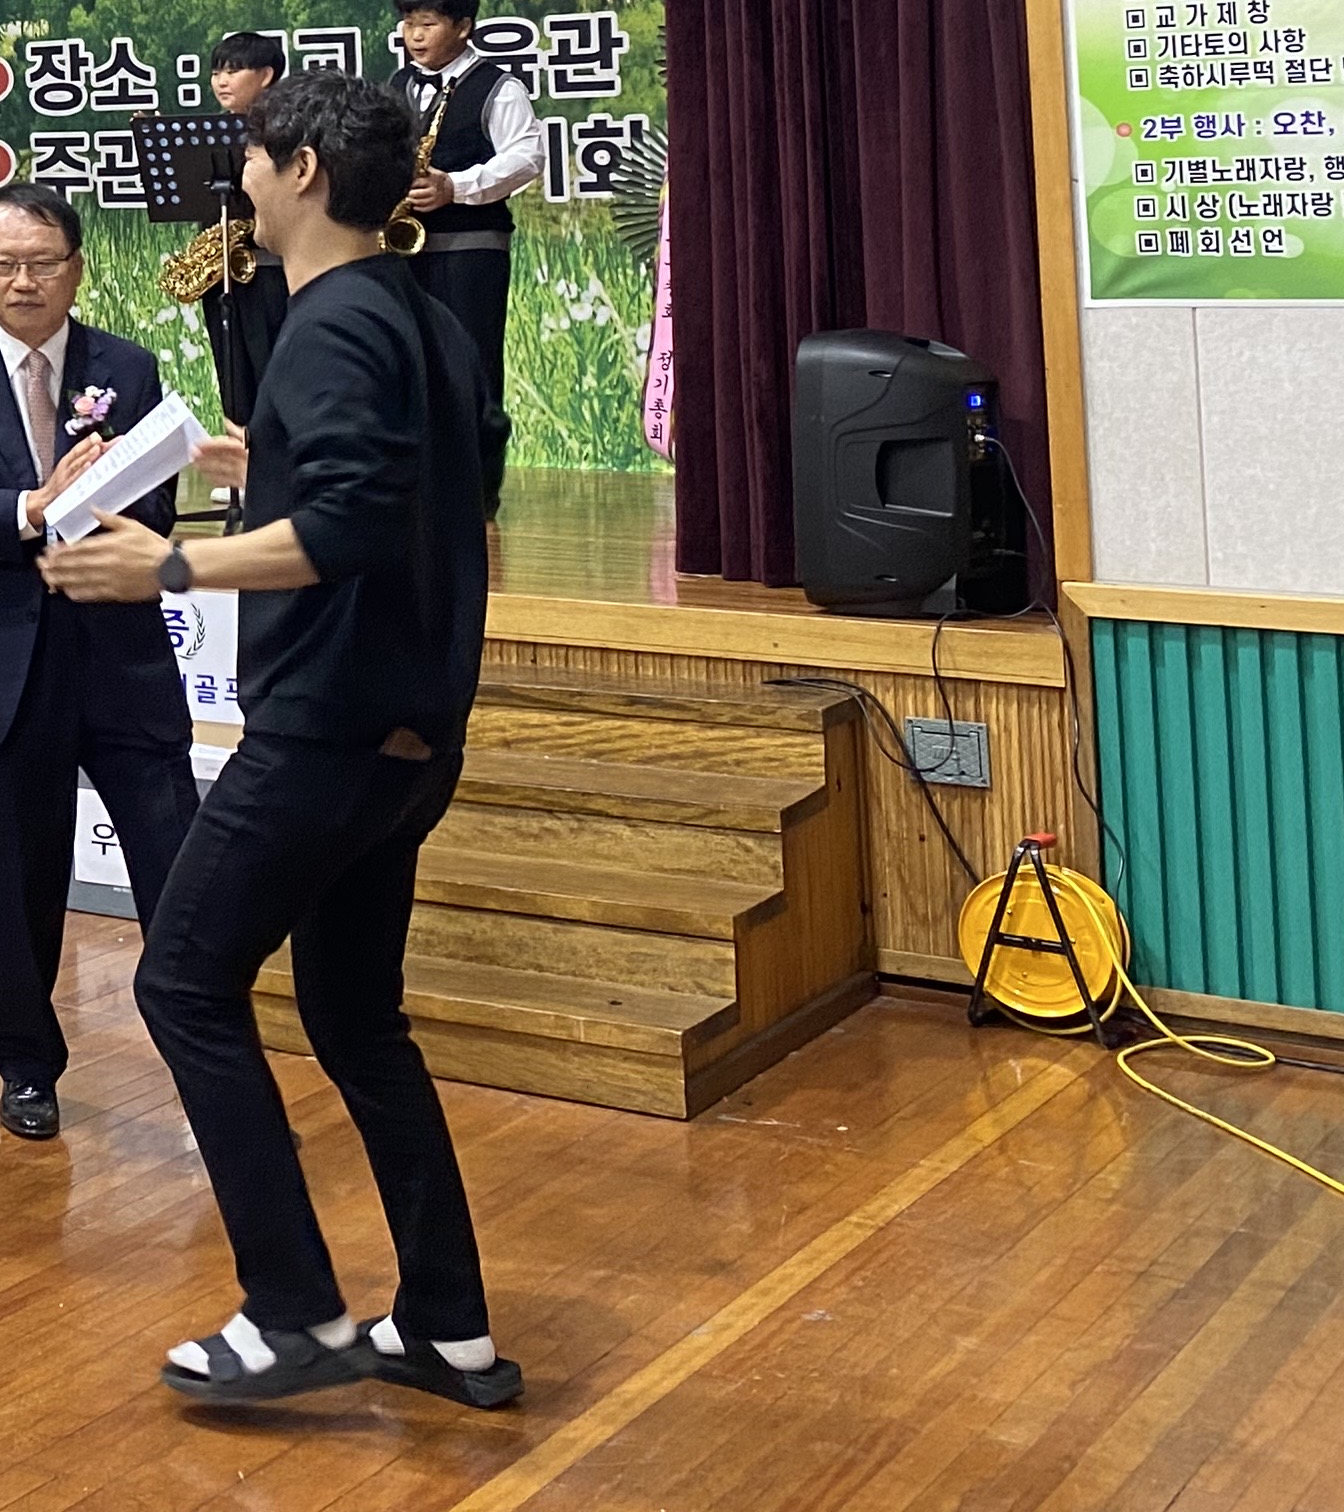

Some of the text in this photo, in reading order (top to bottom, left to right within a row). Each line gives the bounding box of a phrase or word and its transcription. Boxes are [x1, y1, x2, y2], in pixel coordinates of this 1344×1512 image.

[1157, 28, 1306, 58] 기타토의 사항
[28, 41, 155, 112] 장소
[393, 16, 626, 95] 육관
[1159, 60, 1274, 88] 축하시루떡
[1285, 58, 1333, 83] 절단
[1143, 116, 1183, 139] 2부
[1194, 113, 1245, 138] 행사
[1273, 110, 1334, 136] 오찬,
[1164, 157, 1314, 183] 기별노래자랑,
[1229, 192, 1334, 219] (노래자랑
